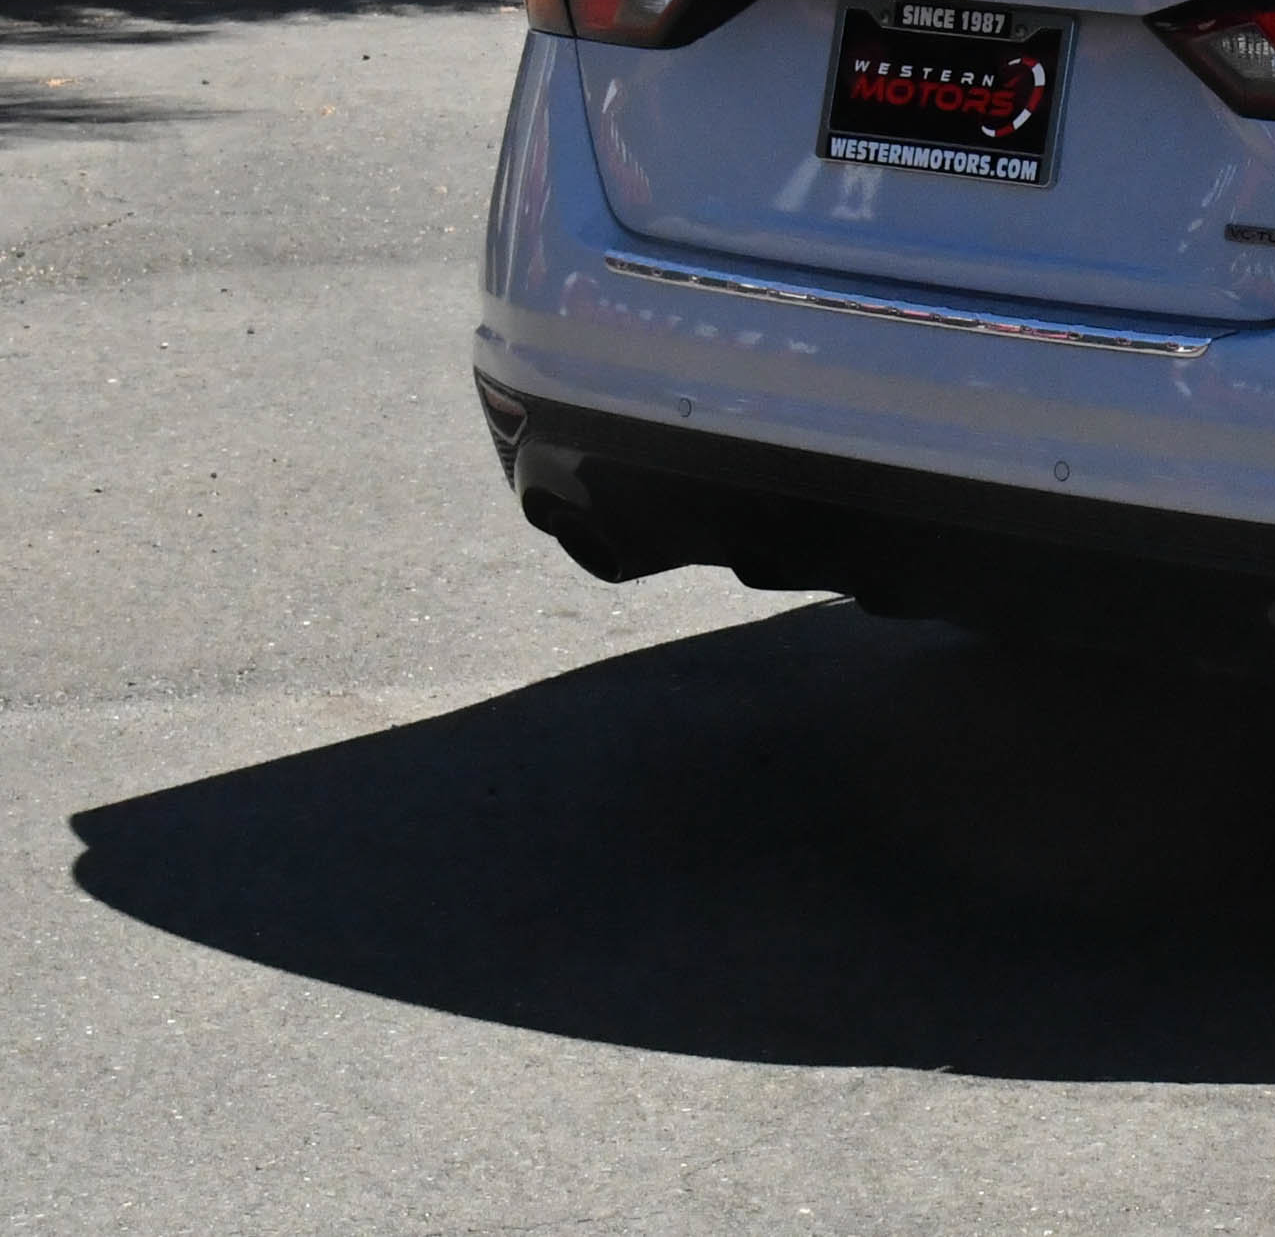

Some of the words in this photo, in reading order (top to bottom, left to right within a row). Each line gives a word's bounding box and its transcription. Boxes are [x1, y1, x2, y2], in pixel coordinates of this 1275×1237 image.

[902, 4, 955, 31] SINCE
[961, 9, 1006, 35] 1987
[854, 59, 995, 87] WESTERN
[851, 74, 1014, 118] MOTORS
[830, 137, 1038, 183] WESTERNMOTORS.COM
